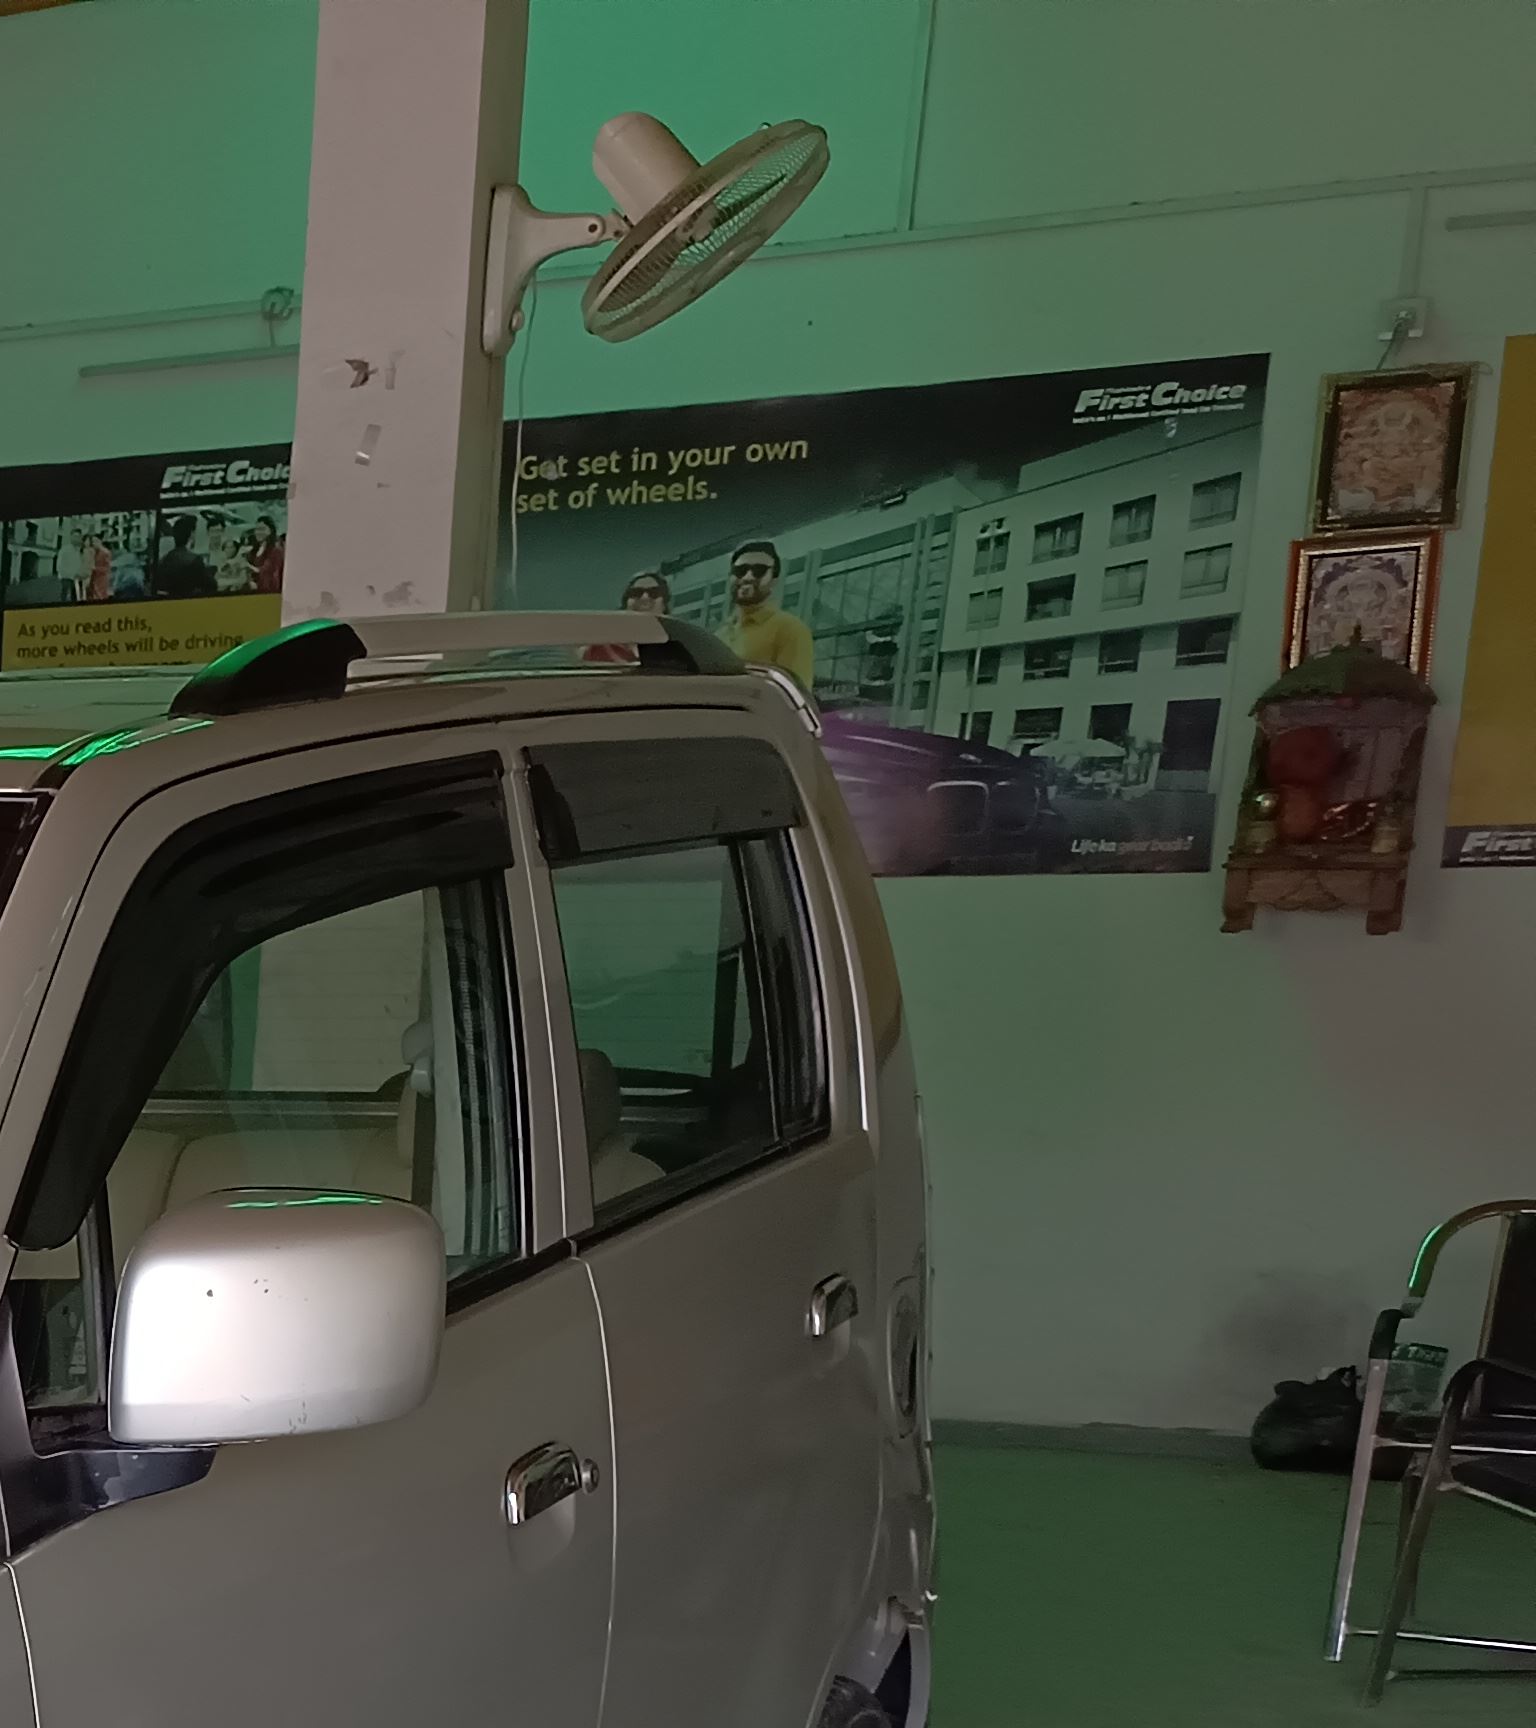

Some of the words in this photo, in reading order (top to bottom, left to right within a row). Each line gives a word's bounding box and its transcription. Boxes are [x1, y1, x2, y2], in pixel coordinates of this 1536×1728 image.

[1074, 388, 1149, 413] First
[1151, 382, 1247, 406] Choice
[578, 450, 620, 476] set
[632, 447, 657, 472] in
[668, 445, 736, 475] your
[745, 439, 808, 463] own
[226, 460, 290, 483] Choic
[516, 488, 559, 513] set
[568, 482, 599, 509] of
[607, 475, 717, 505] wheels.
[18, 623, 35, 638] As
[41, 622, 70, 640] you
[75, 617, 112, 635] read
[117, 616, 152, 634] this,
[16, 643, 57, 658] more
[63, 638, 119, 656] wheels
[124, 637, 154, 652] will
[159, 635, 180, 650] be
